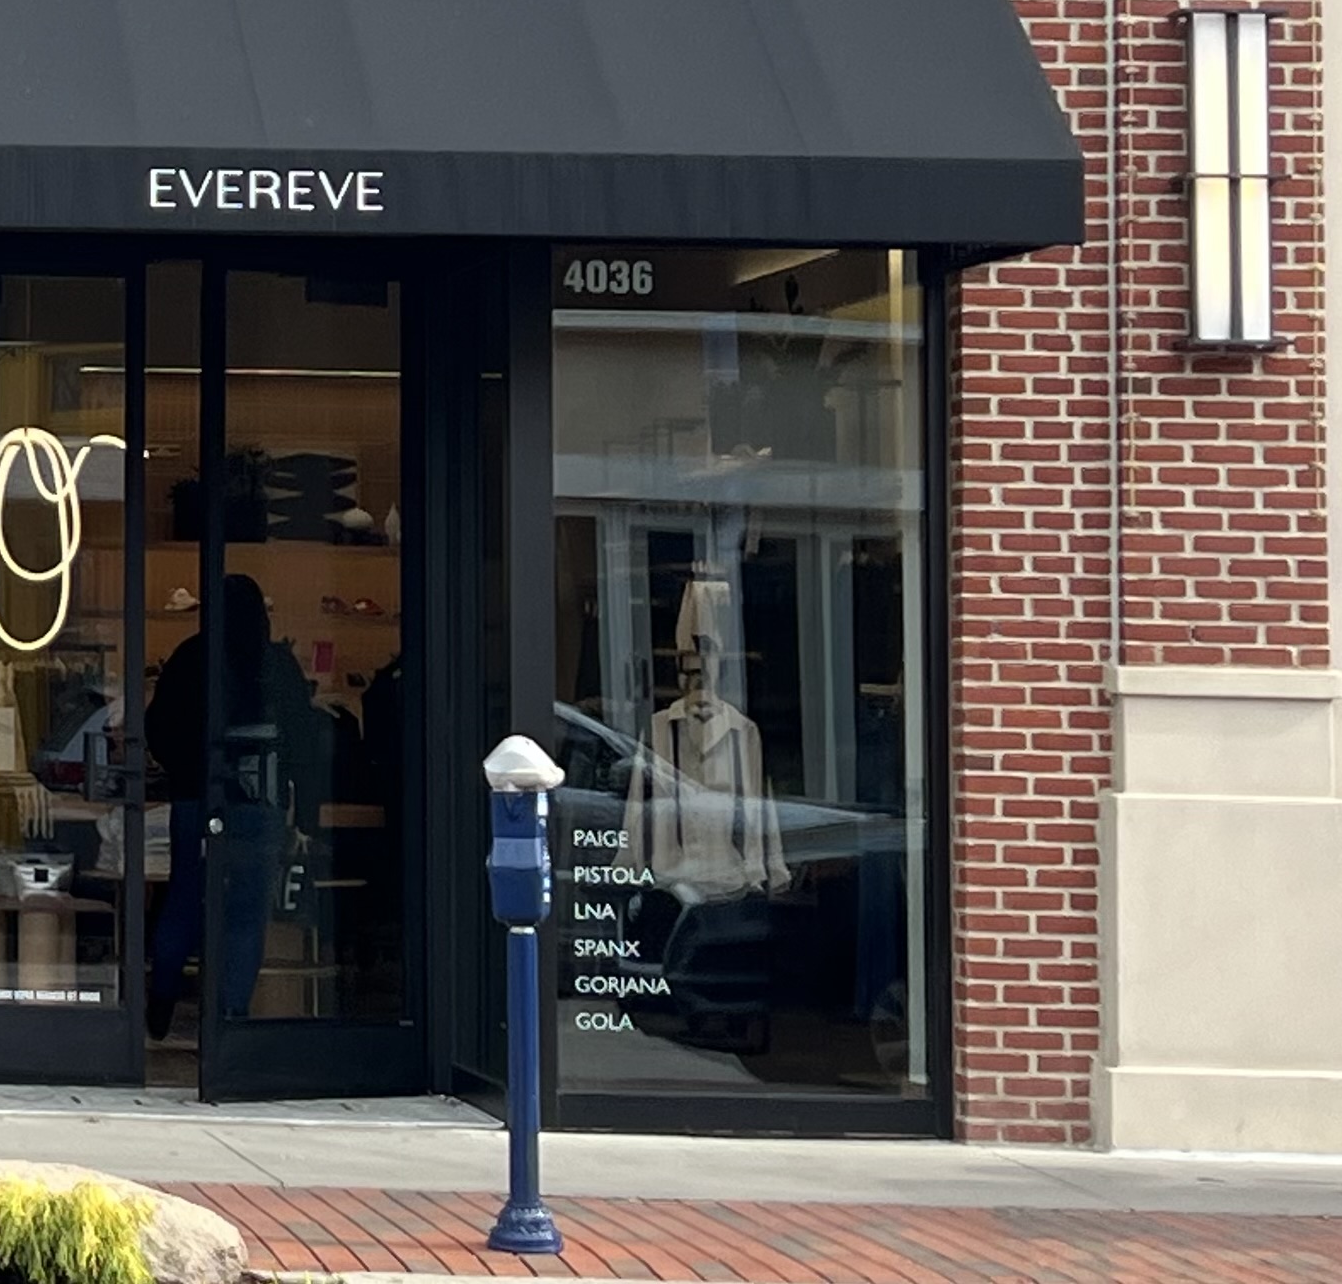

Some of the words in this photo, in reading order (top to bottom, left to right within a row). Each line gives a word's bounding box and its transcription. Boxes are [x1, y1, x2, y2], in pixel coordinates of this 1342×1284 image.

[148, 168, 384, 212] EVEREVE
[563, 259, 654, 295] 4036
[573, 829, 630, 849] PAIGE
[573, 866, 656, 885] PISTOLA
[574, 902, 617, 921] LNA
[574, 939, 642, 958] SPANX
[574, 975, 672, 999] GORJANA
[575, 1012, 635, 1032] GOLA
